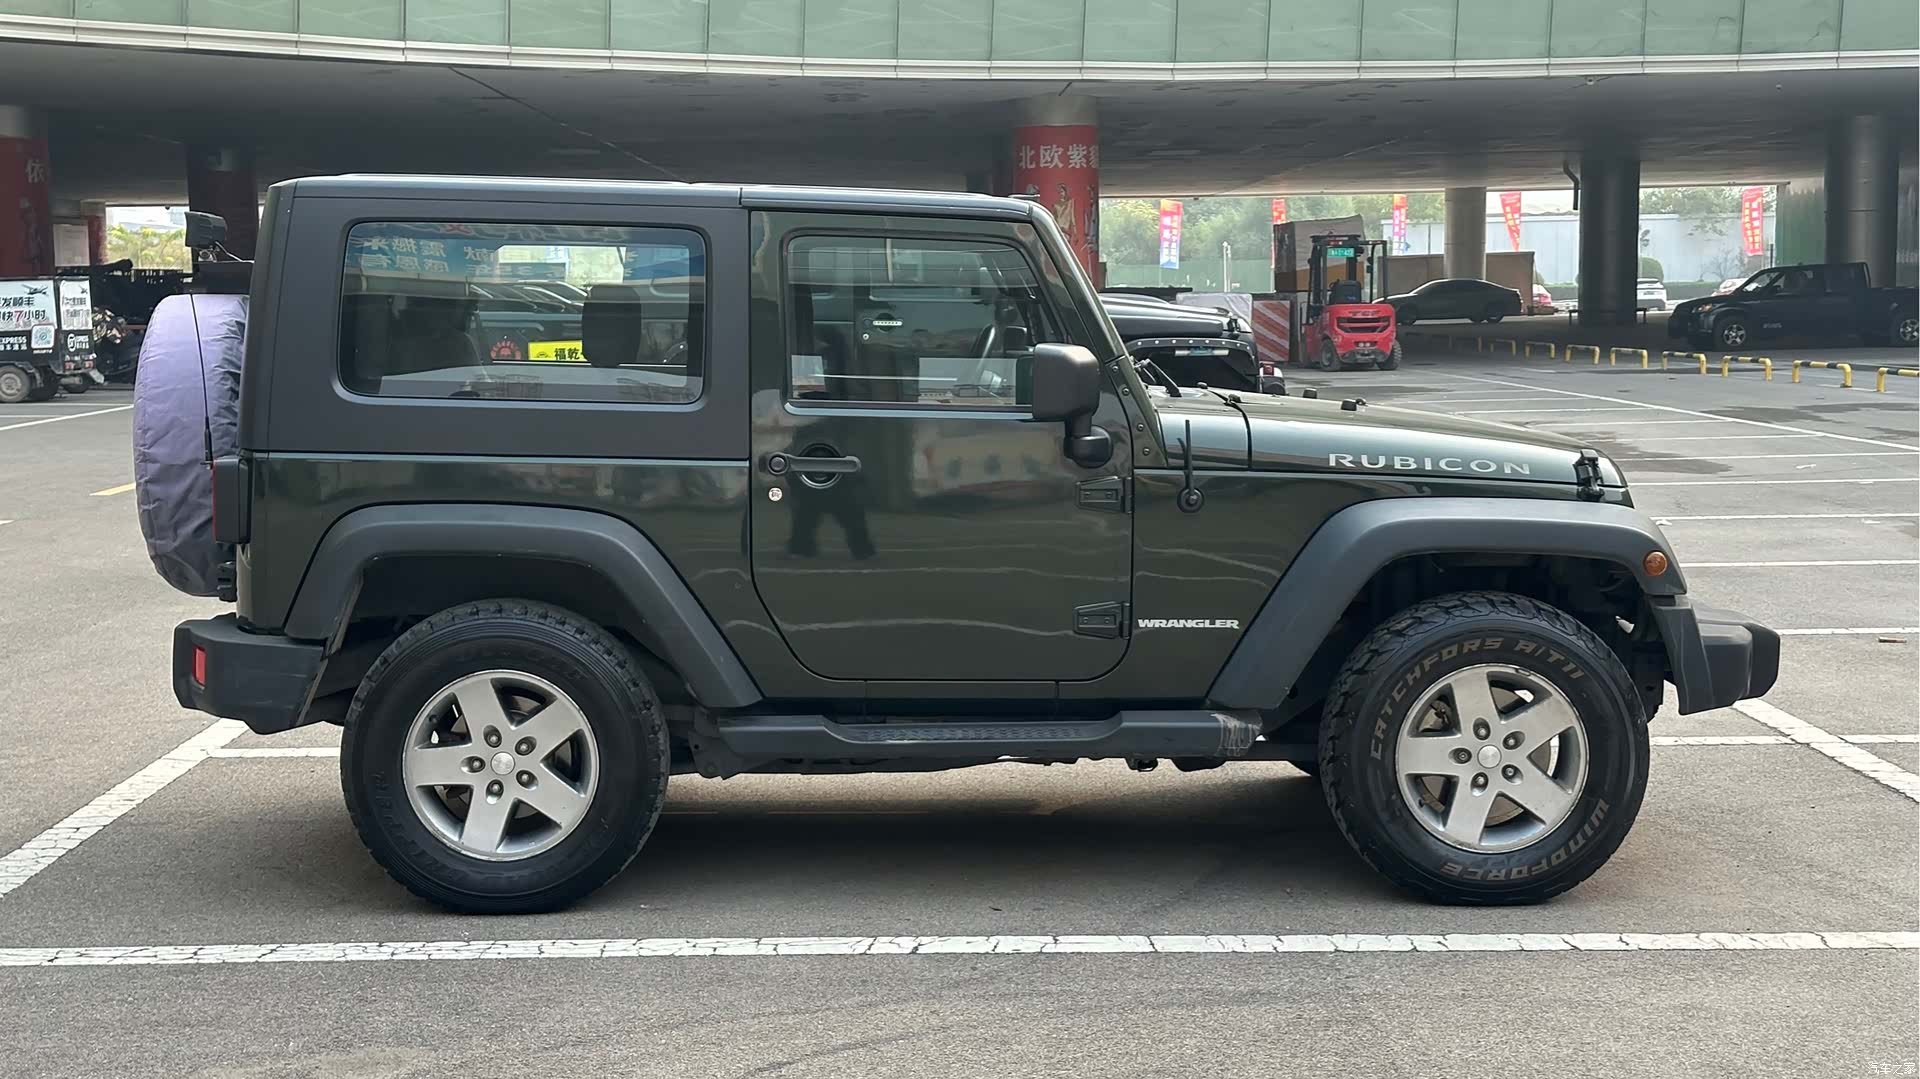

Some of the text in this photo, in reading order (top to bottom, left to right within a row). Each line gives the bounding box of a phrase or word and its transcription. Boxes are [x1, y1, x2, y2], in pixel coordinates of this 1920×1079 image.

[0, 296, 35, 307] 发顺丰
[0, 309, 46, 322] 快7小时
[554, 347, 583, 361] 福乾
[1328, 453, 1531, 475] RUBICON
[1137, 619, 1240, 630] WRANGLER
[1370, 637, 1505, 761] CATCHFORS
[1440, 798, 1611, 881] WINDFORCE
